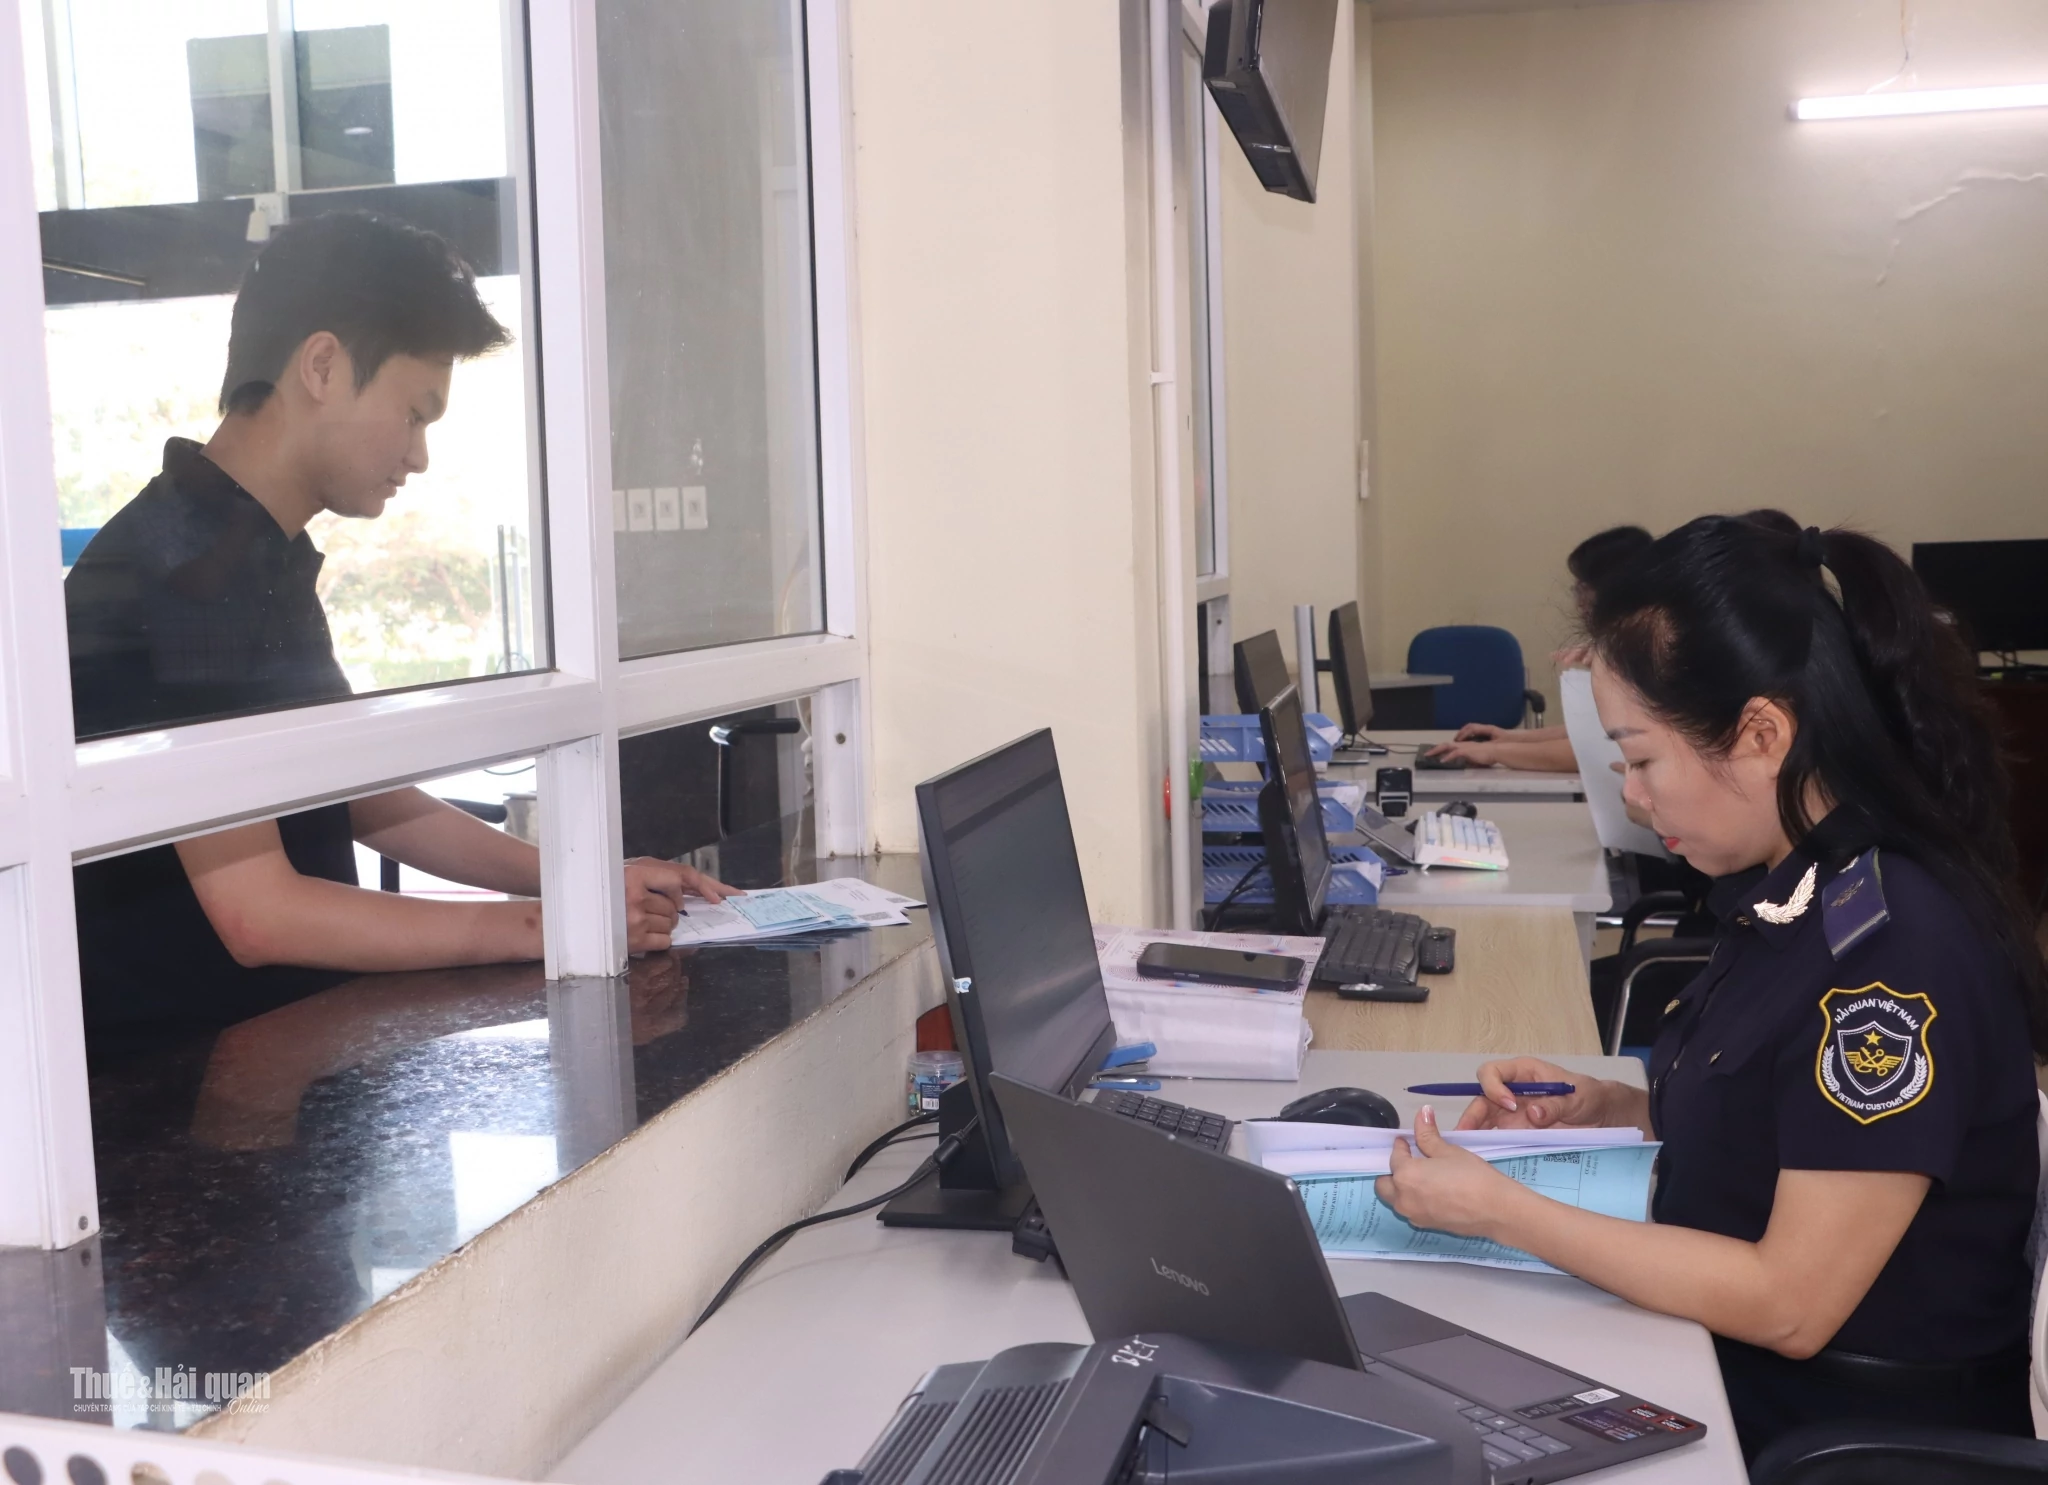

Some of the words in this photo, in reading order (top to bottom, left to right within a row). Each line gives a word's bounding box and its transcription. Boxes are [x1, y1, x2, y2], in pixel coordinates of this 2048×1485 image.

[1834, 1007, 1850, 1024] HẢI
[1848, 998, 1876, 1013] QUAN
[1877, 999, 1901, 1014] VIỆT
[1897, 1008, 1920, 1031] NAM
[1836, 1090, 1864, 1110] VIETNAM
[1865, 1096, 1904, 1111] CUSTOMS
[1150, 1257, 1209, 1296] Lenovo
